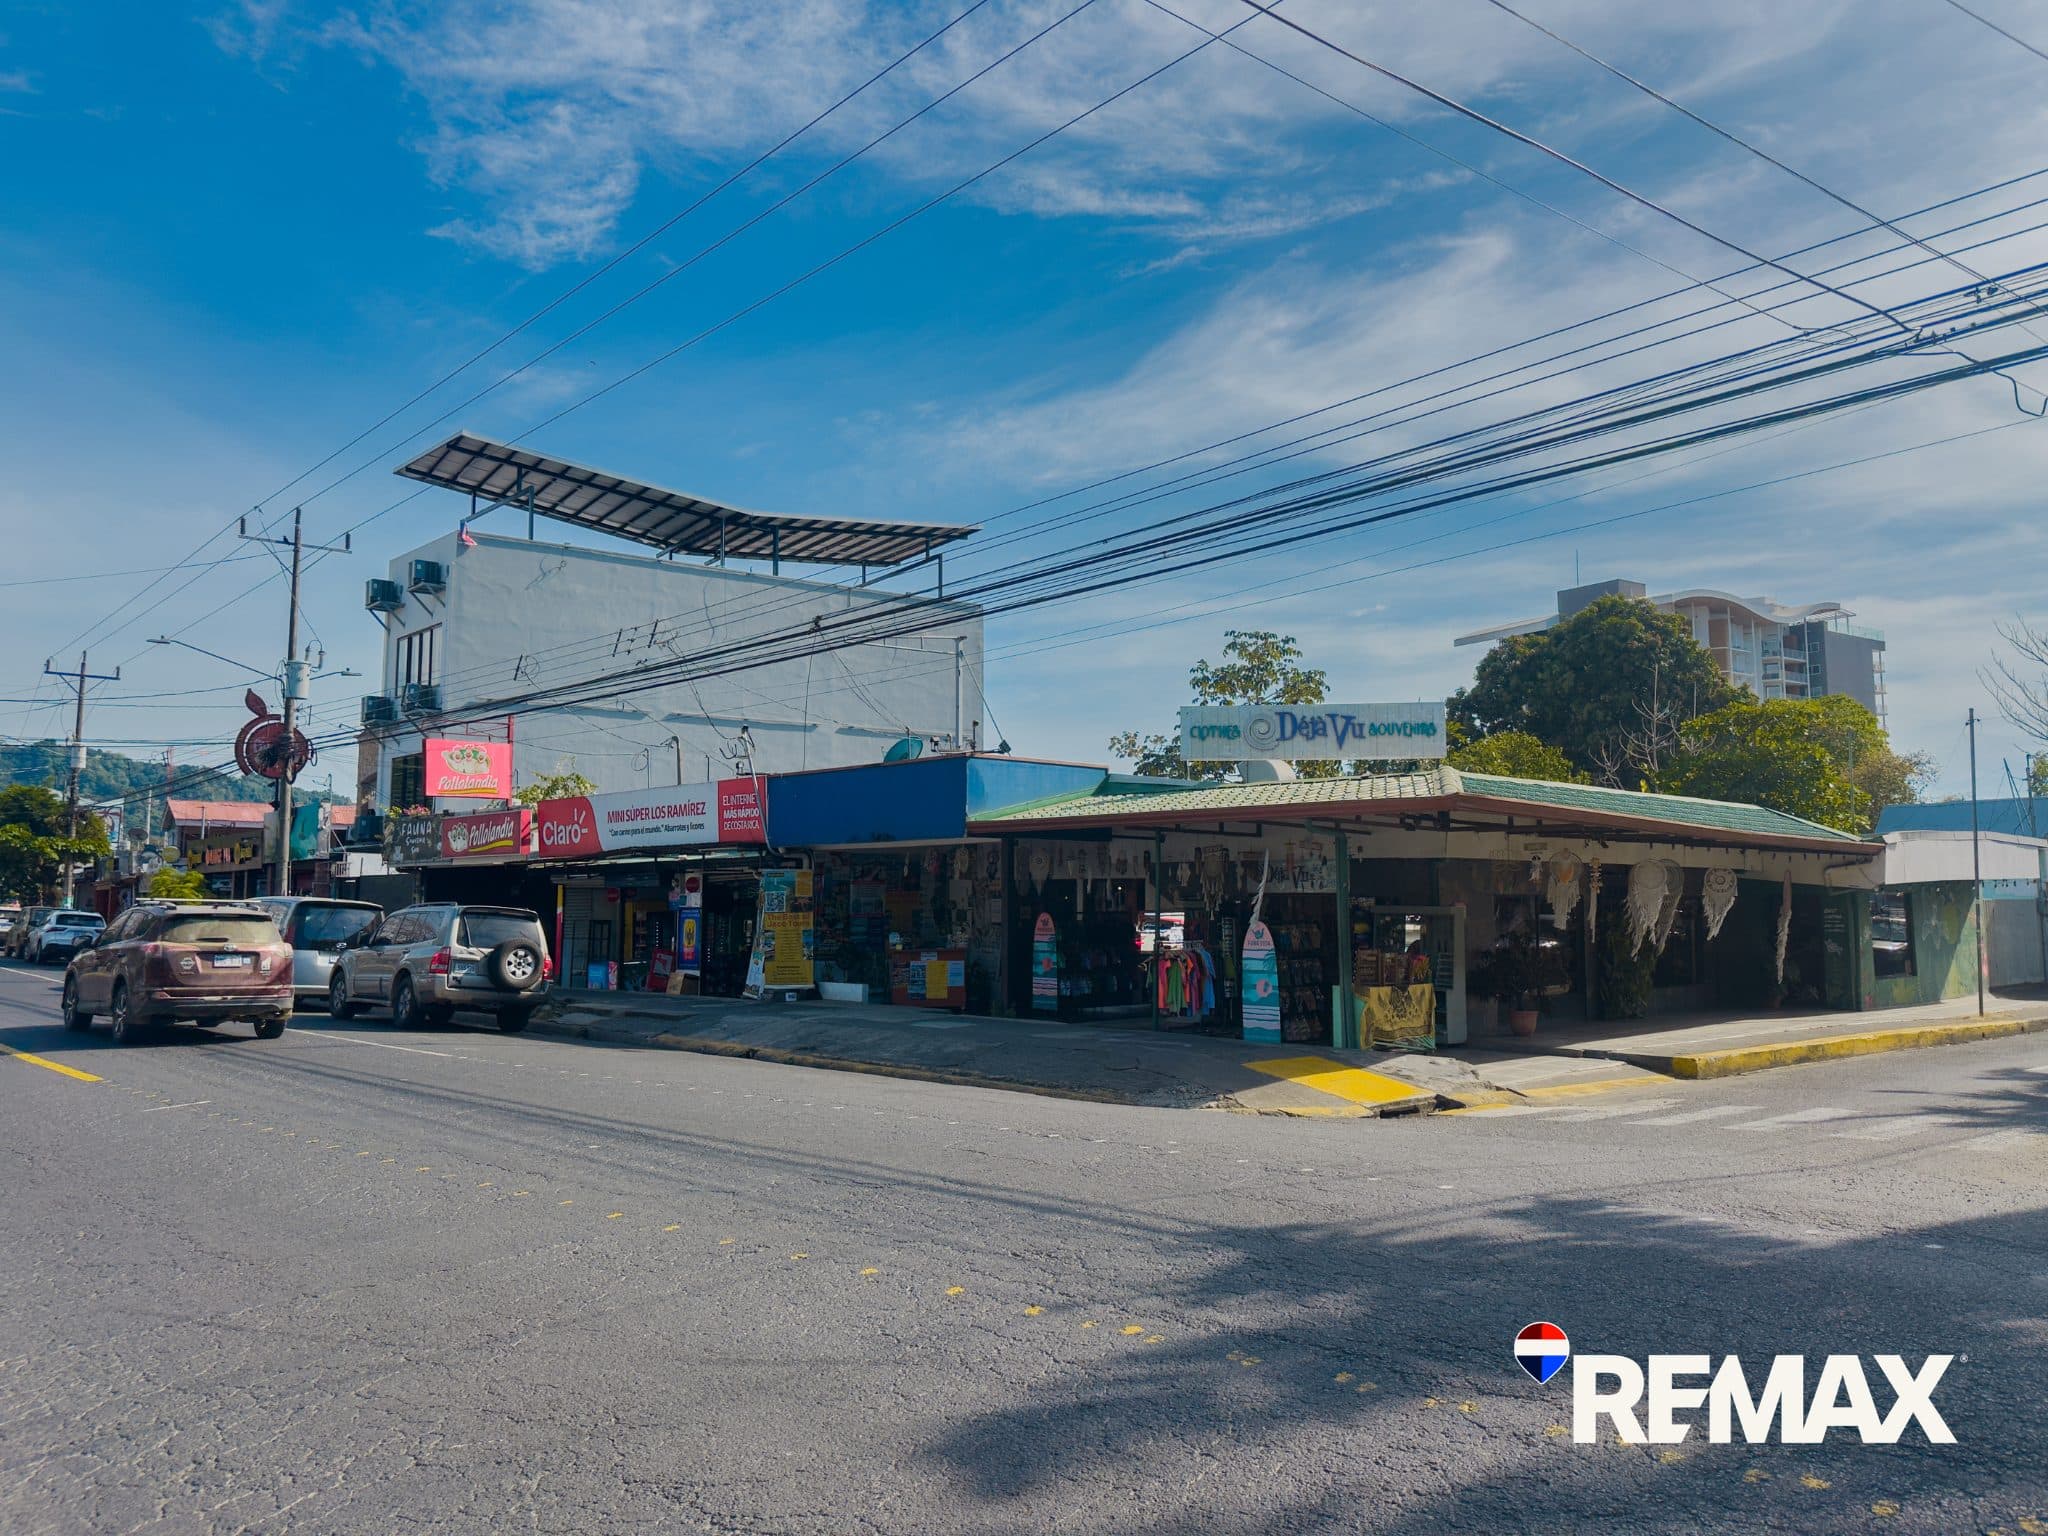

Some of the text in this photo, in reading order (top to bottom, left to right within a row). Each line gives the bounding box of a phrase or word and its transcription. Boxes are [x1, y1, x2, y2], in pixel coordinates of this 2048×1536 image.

[1274, 711, 1328, 742] Déjà
[1325, 713, 1366, 750] Vu
[1368, 721, 1438, 738] SOUVENIRS
[438, 775, 498, 790] Pollolandia
[607, 799, 706, 823] MINI SÚPER LOS RAMÍREZ
[469, 816, 514, 846] Pollolandia
[543, 820, 581, 846] Claro
